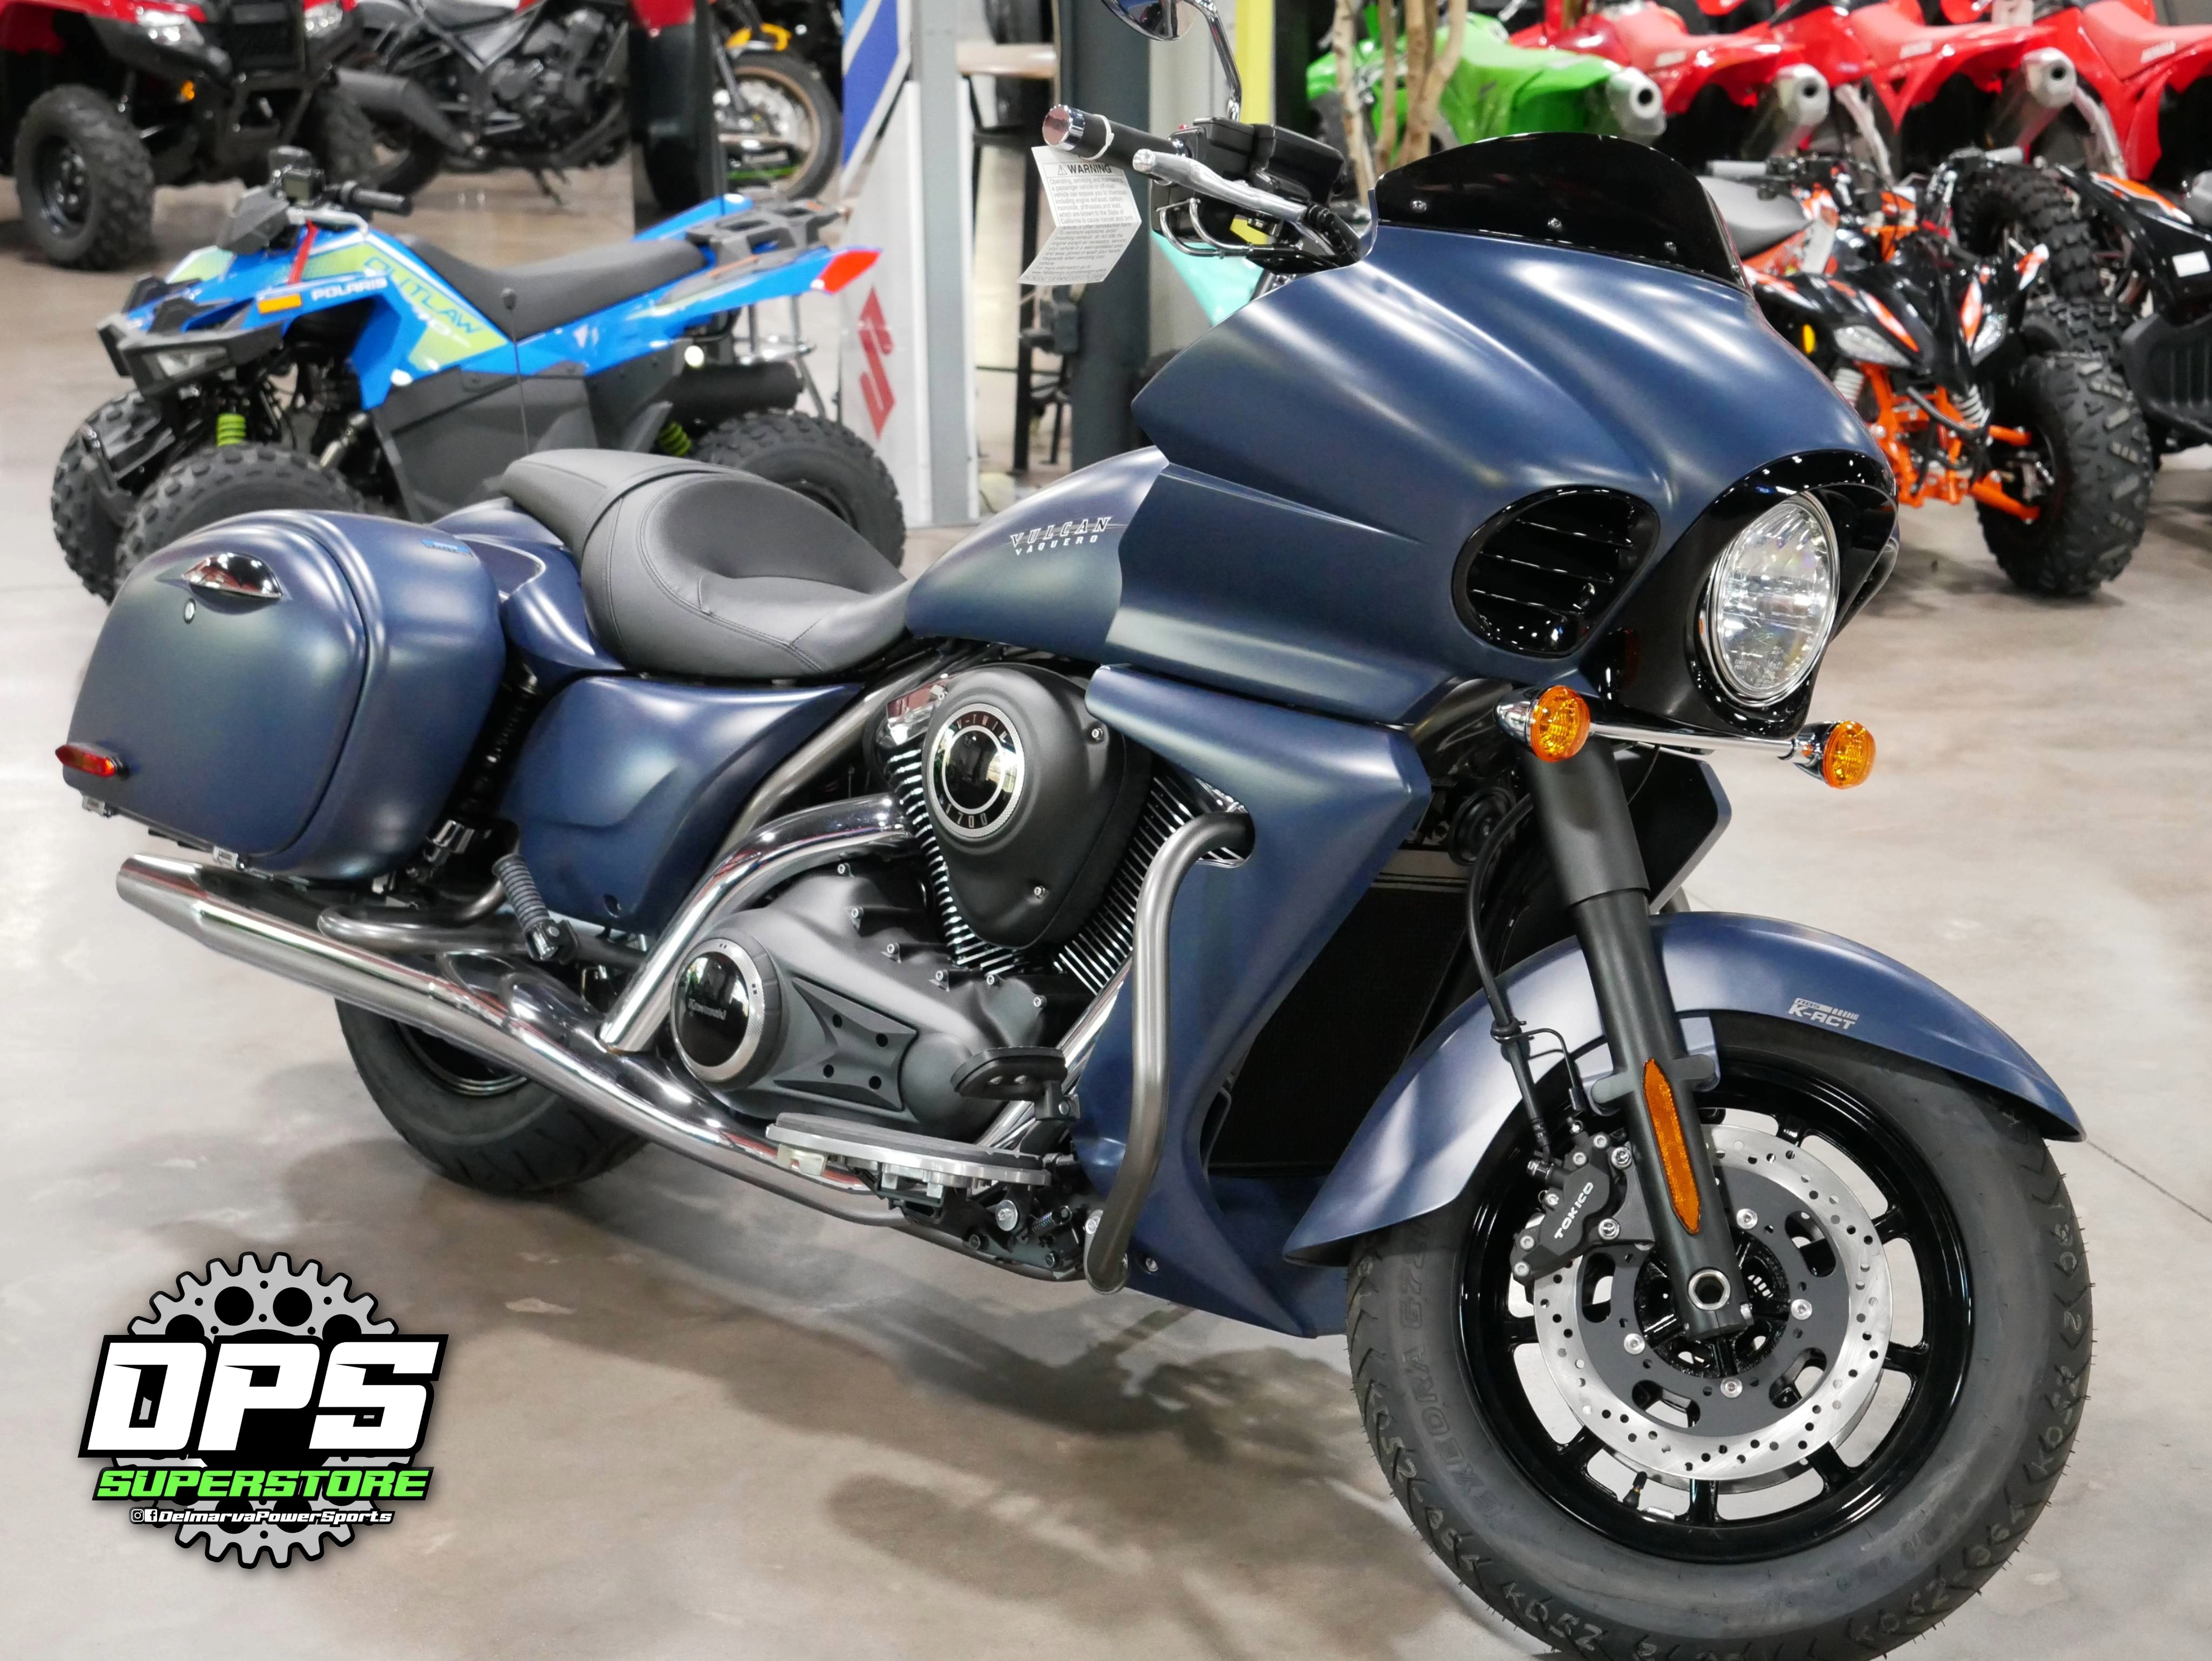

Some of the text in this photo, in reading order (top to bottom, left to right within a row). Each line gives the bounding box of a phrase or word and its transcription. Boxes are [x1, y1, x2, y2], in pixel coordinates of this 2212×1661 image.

[1067, 164, 1112, 174] WARNING
[311, 277, 387, 302] POLARIS
[364, 256, 484, 335] OUTLAW
[1010, 516, 1113, 548] VULCAN
[1015, 535, 1098, 556] VAQUERO
[945, 803, 988, 829] 1700
[1788, 1003, 1856, 1030] K-ACT
[1554, 1181, 1594, 1239] TOKICO
